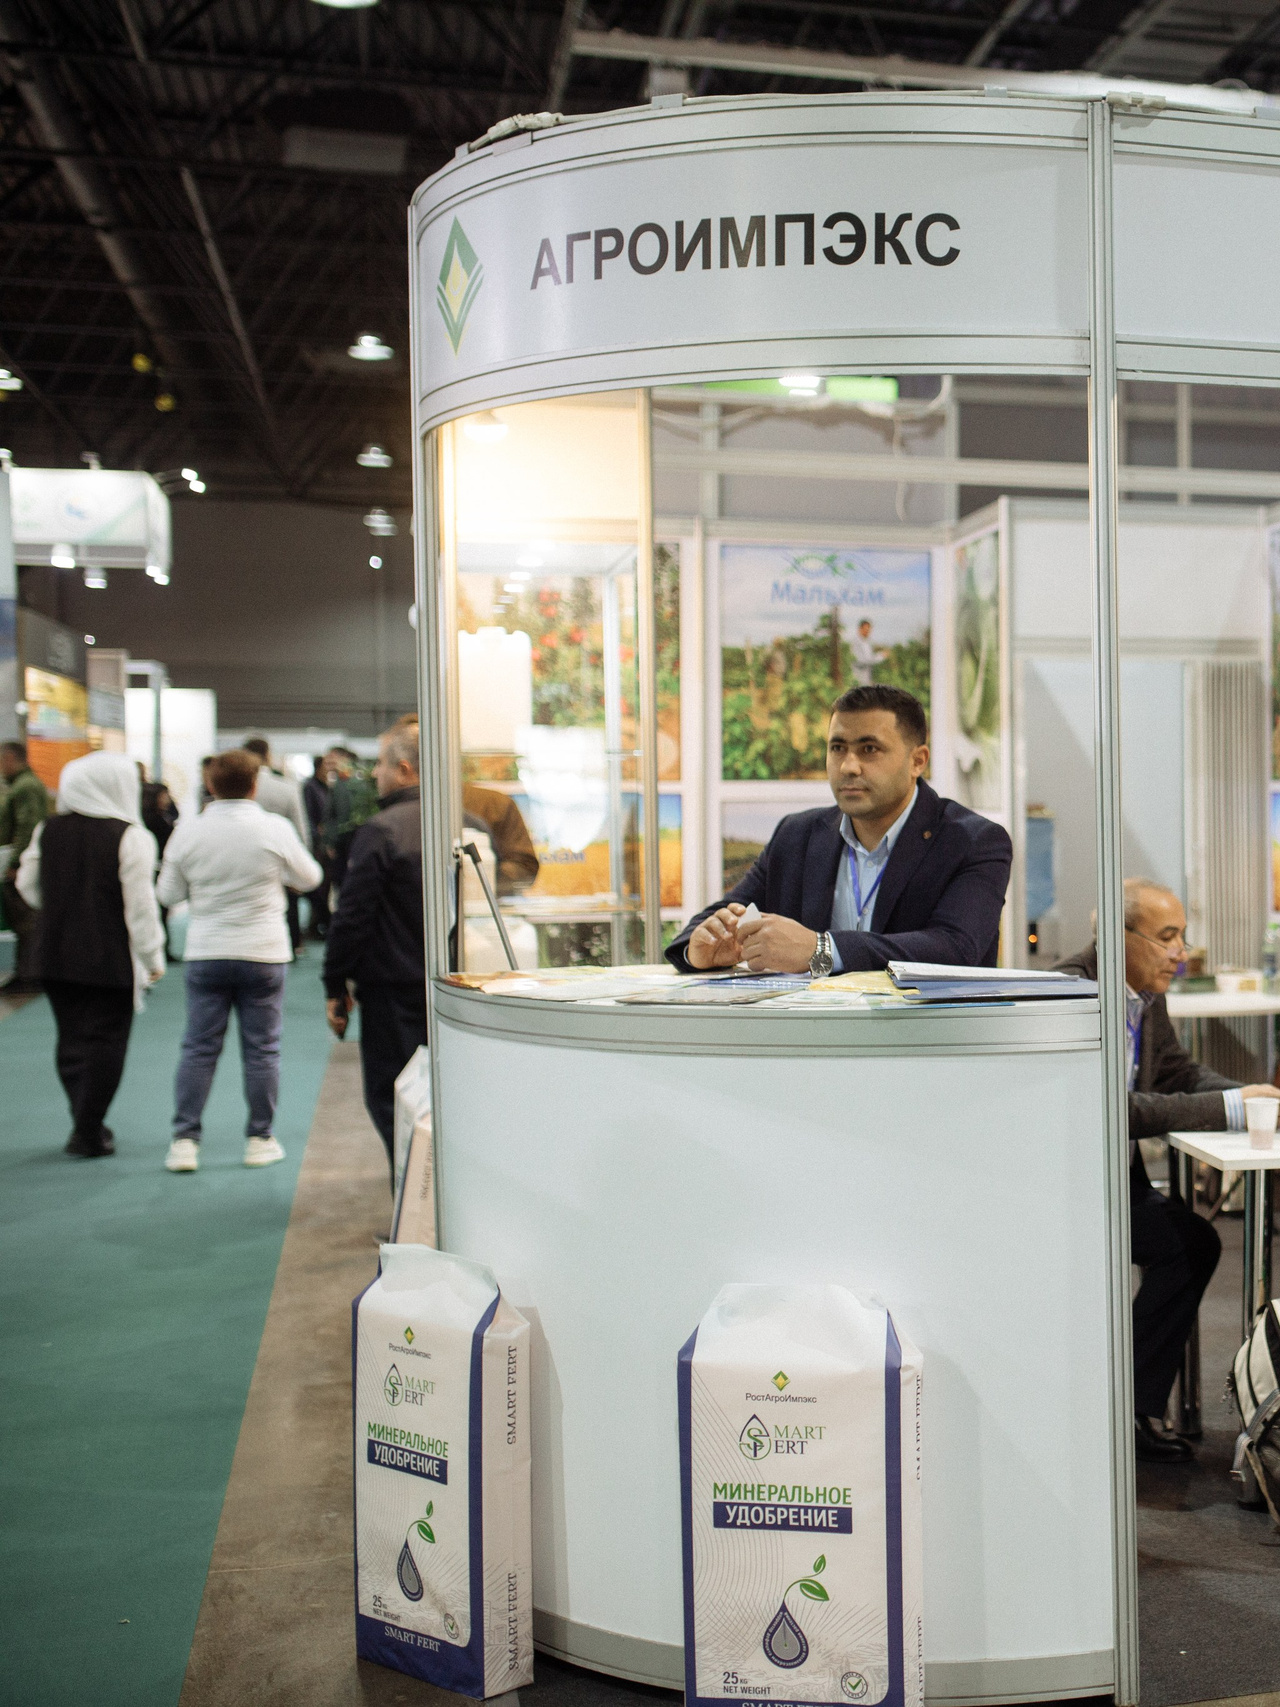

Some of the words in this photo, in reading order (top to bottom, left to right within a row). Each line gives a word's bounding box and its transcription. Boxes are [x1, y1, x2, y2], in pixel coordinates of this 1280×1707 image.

[530, 211, 962, 291] АГРОИМПЭКС
[507, 1345, 517, 1387] FERT
[745, 1392, 818, 1404] РостАгроИмпэкс
[506, 1389, 517, 1445] SMART
[367, 1421, 449, 1458] МИНЕРАЛЬНОЕ
[374, 1443, 440, 1478] УДОБРЕНИЕ
[712, 1482, 852, 1505] МИНЕРАЛЬНОЕ
[725, 1505, 839, 1528] УДОБРЕНИЕ
[372, 1594, 382, 1608] 25
[507, 1572, 518, 1613] FERT
[384, 1625, 416, 1644] SMART
[416, 1635, 441, 1653] FERT
[508, 1616, 520, 1671] SMART
[722, 1671, 739, 1685] 25
[723, 1685, 738, 1694] NET
[740, 1686, 771, 1695] WEIGHT
